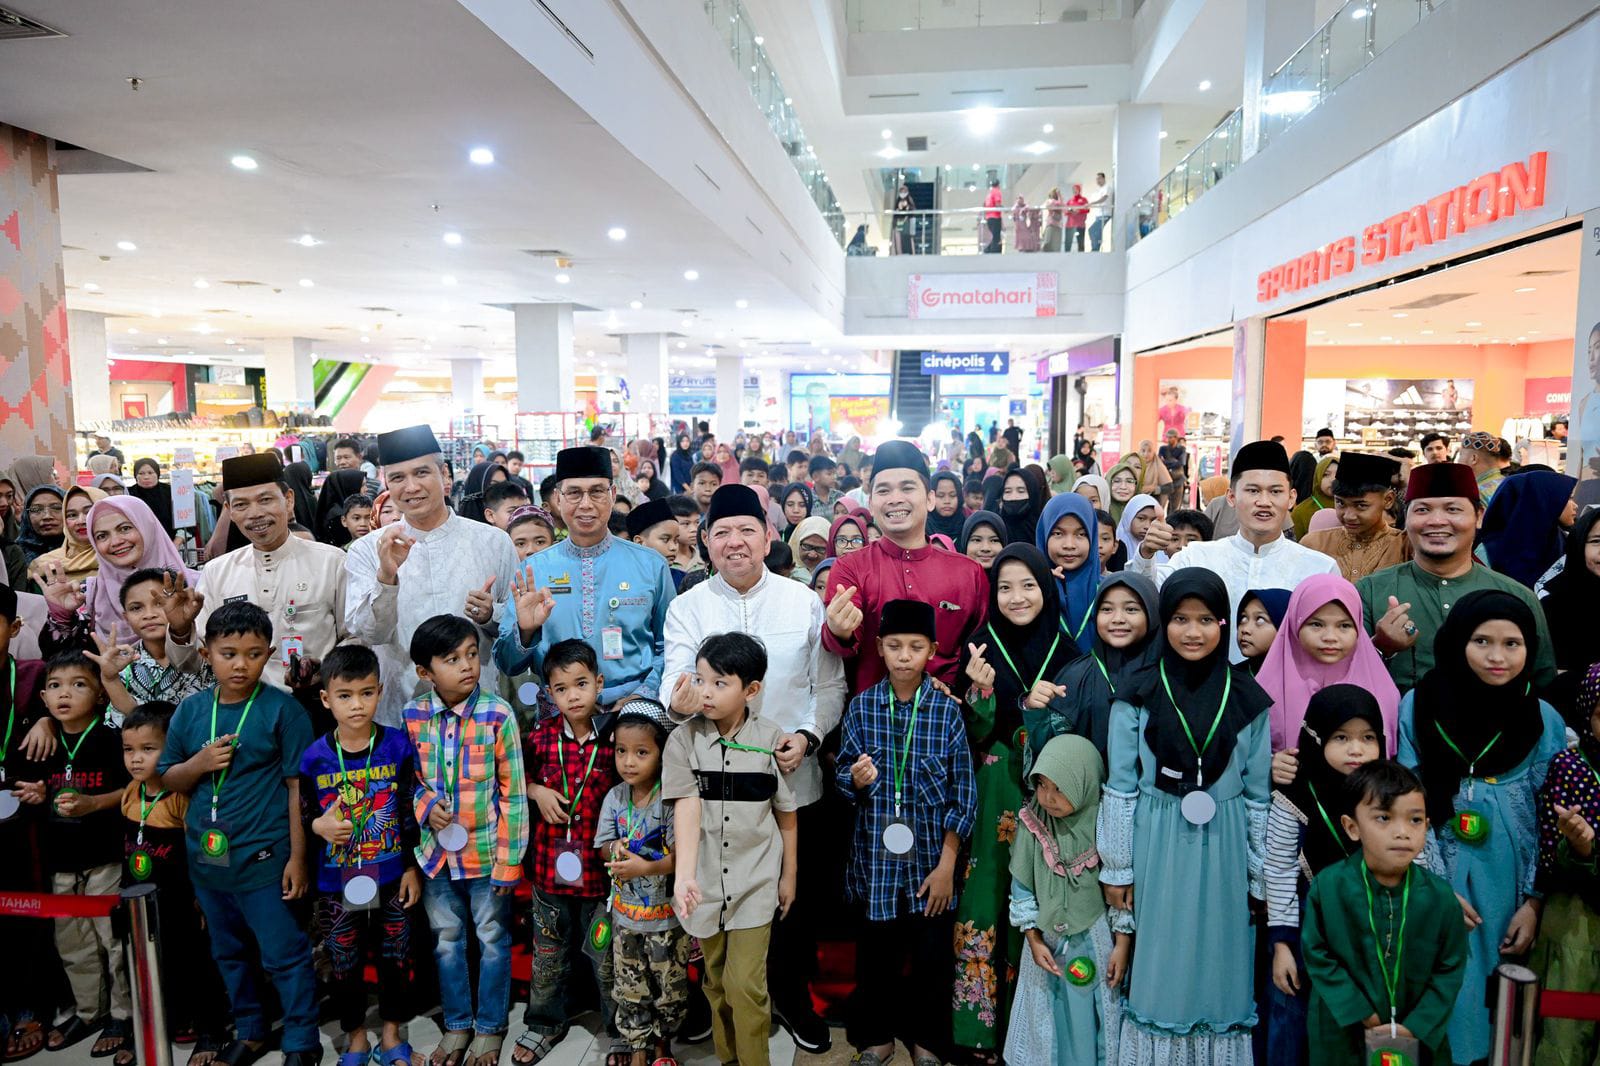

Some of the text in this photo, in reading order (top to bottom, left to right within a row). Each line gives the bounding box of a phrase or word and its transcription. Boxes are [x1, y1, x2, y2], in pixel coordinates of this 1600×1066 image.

[1257, 151, 1547, 303] SPORTS STATION
[942, 287, 1032, 304] matahari
[48, 771, 103, 788] ONERSE
[316, 763, 396, 790] SUPERMAN
[1, 896, 41, 910] TAHARI
